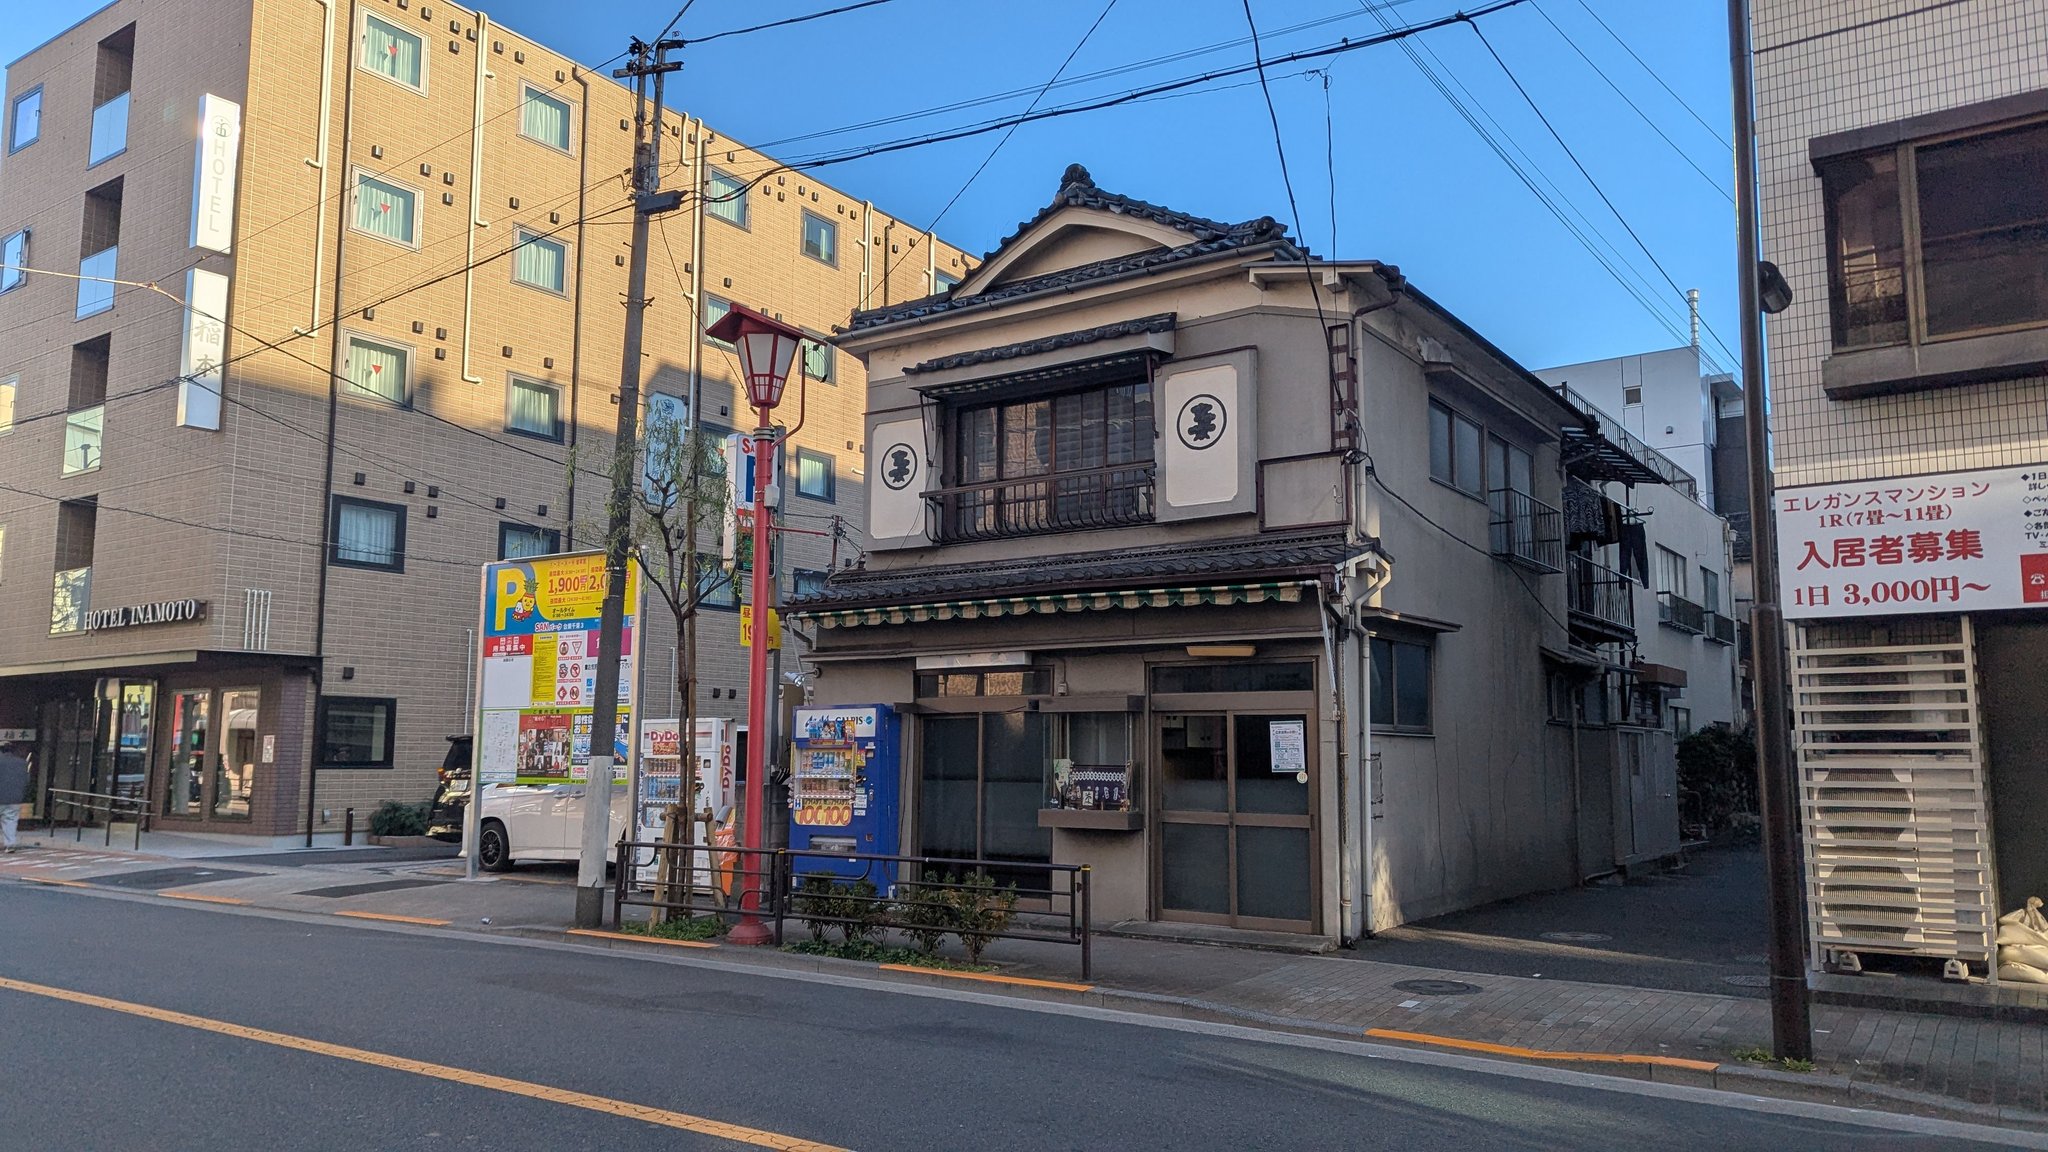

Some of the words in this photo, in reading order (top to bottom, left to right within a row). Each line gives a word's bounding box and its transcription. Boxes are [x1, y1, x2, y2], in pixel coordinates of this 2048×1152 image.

[208, 138, 227, 234] HOTEL
[1783, 481, 1991, 513] エレガンスマンション
[2029, 482, 2048, 491] 詳し
[1796, 528, 1984, 571] 入居者募集
[494, 567, 527, 632] P
[1794, 584, 1829, 607] 1日
[1843, 575, 1992, 607] 3,000円～
[84, 607, 126, 631] HOTEL
[129, 599, 196, 625] INAMOTO
[650, 731, 679, 742] DyDo
[721, 744, 732, 789] DyDo
[824, 805, 852, 825] 100
